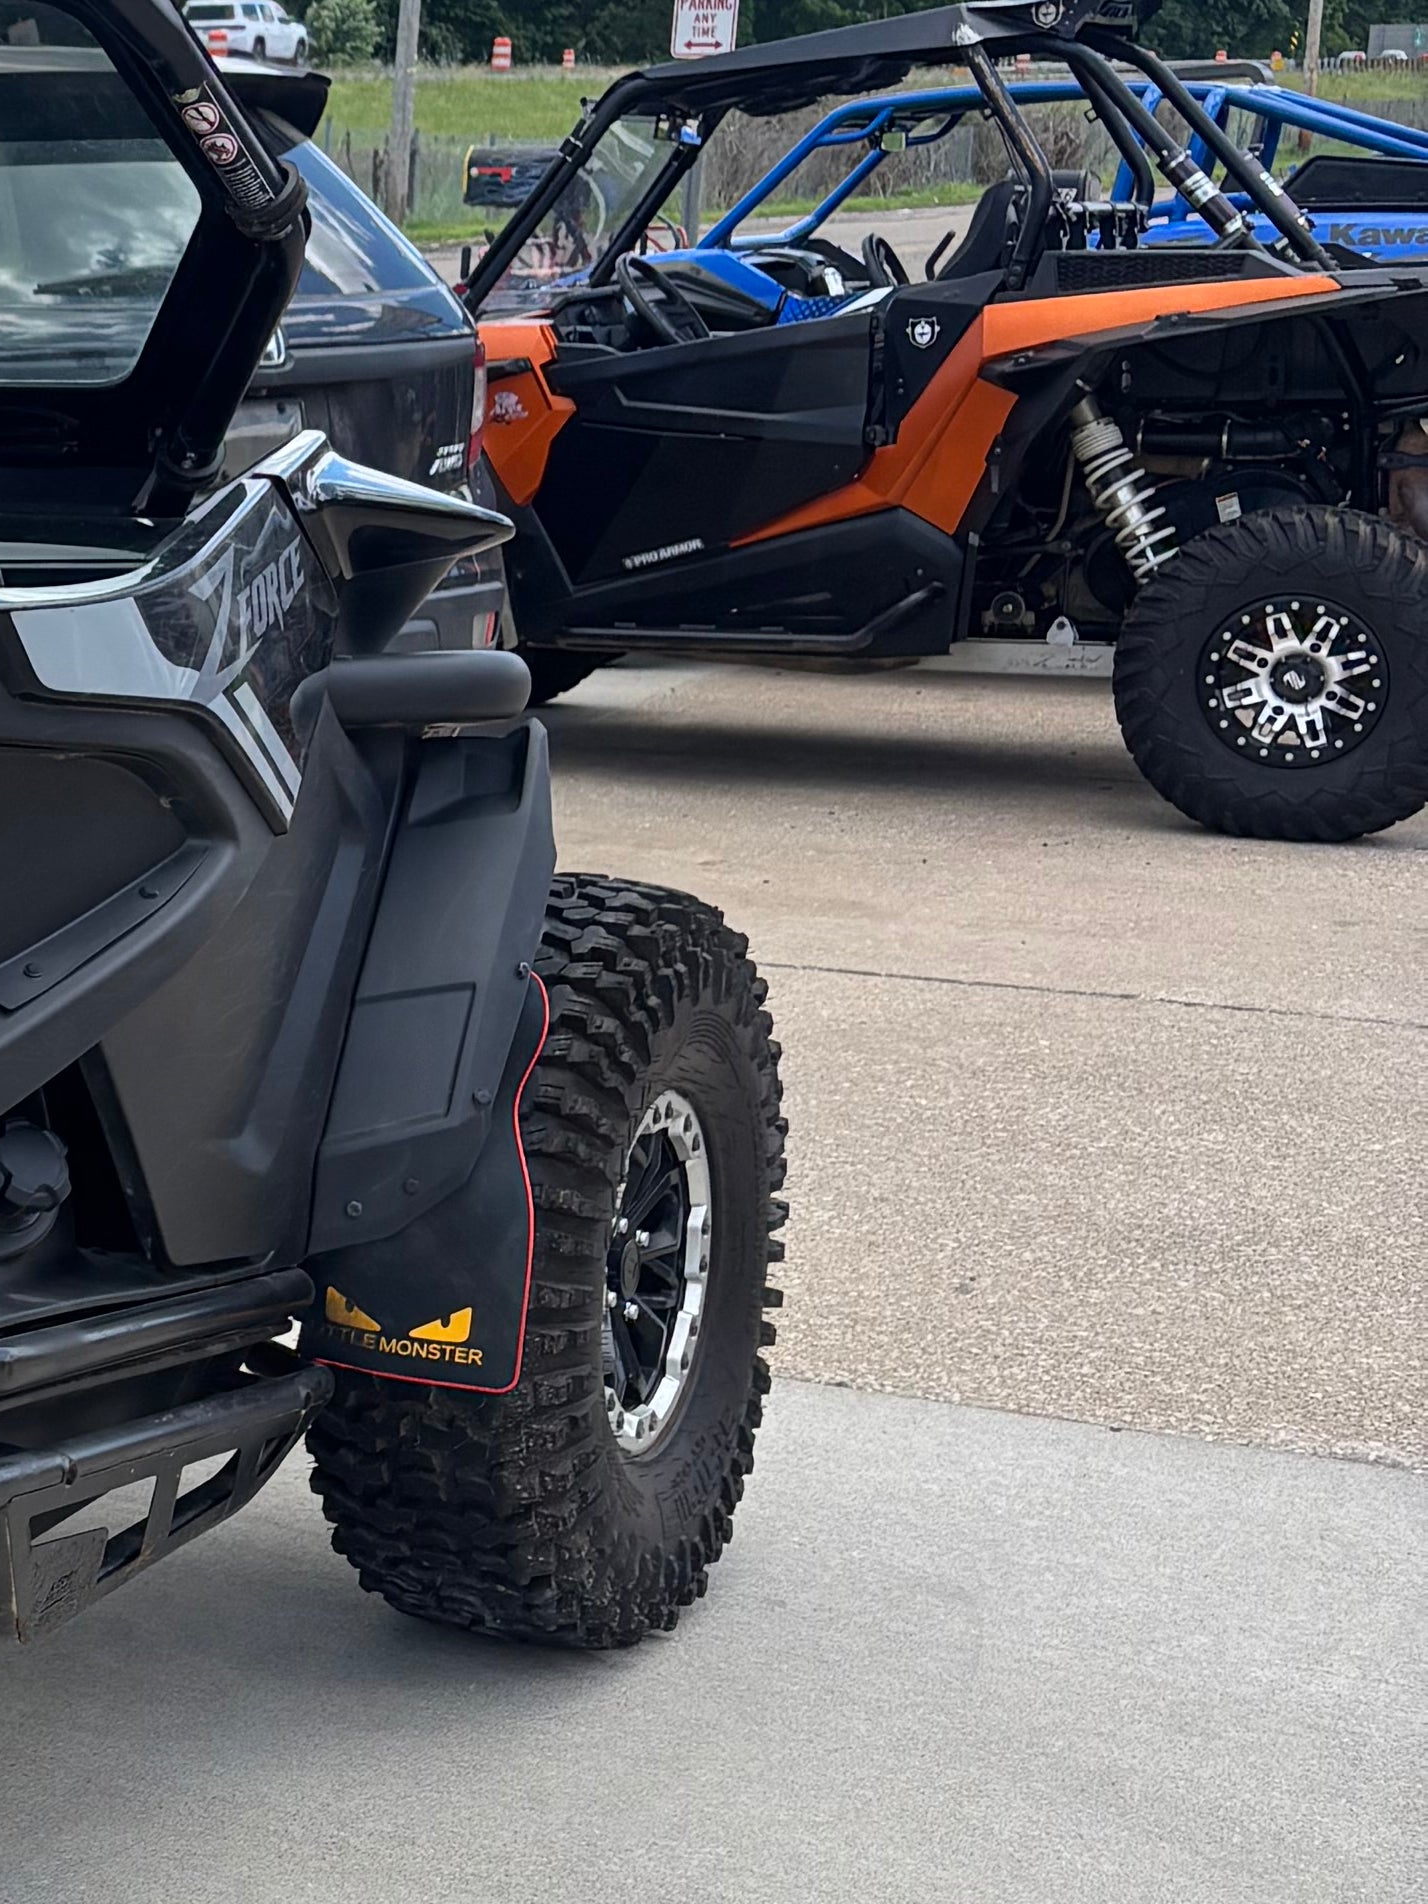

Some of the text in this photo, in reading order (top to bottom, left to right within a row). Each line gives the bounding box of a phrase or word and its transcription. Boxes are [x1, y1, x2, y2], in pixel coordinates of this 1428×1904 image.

[693, 13, 717, 24] ANY
[692, 26, 717, 38] TIME
[379, 1336, 482, 1366] MONSTER
